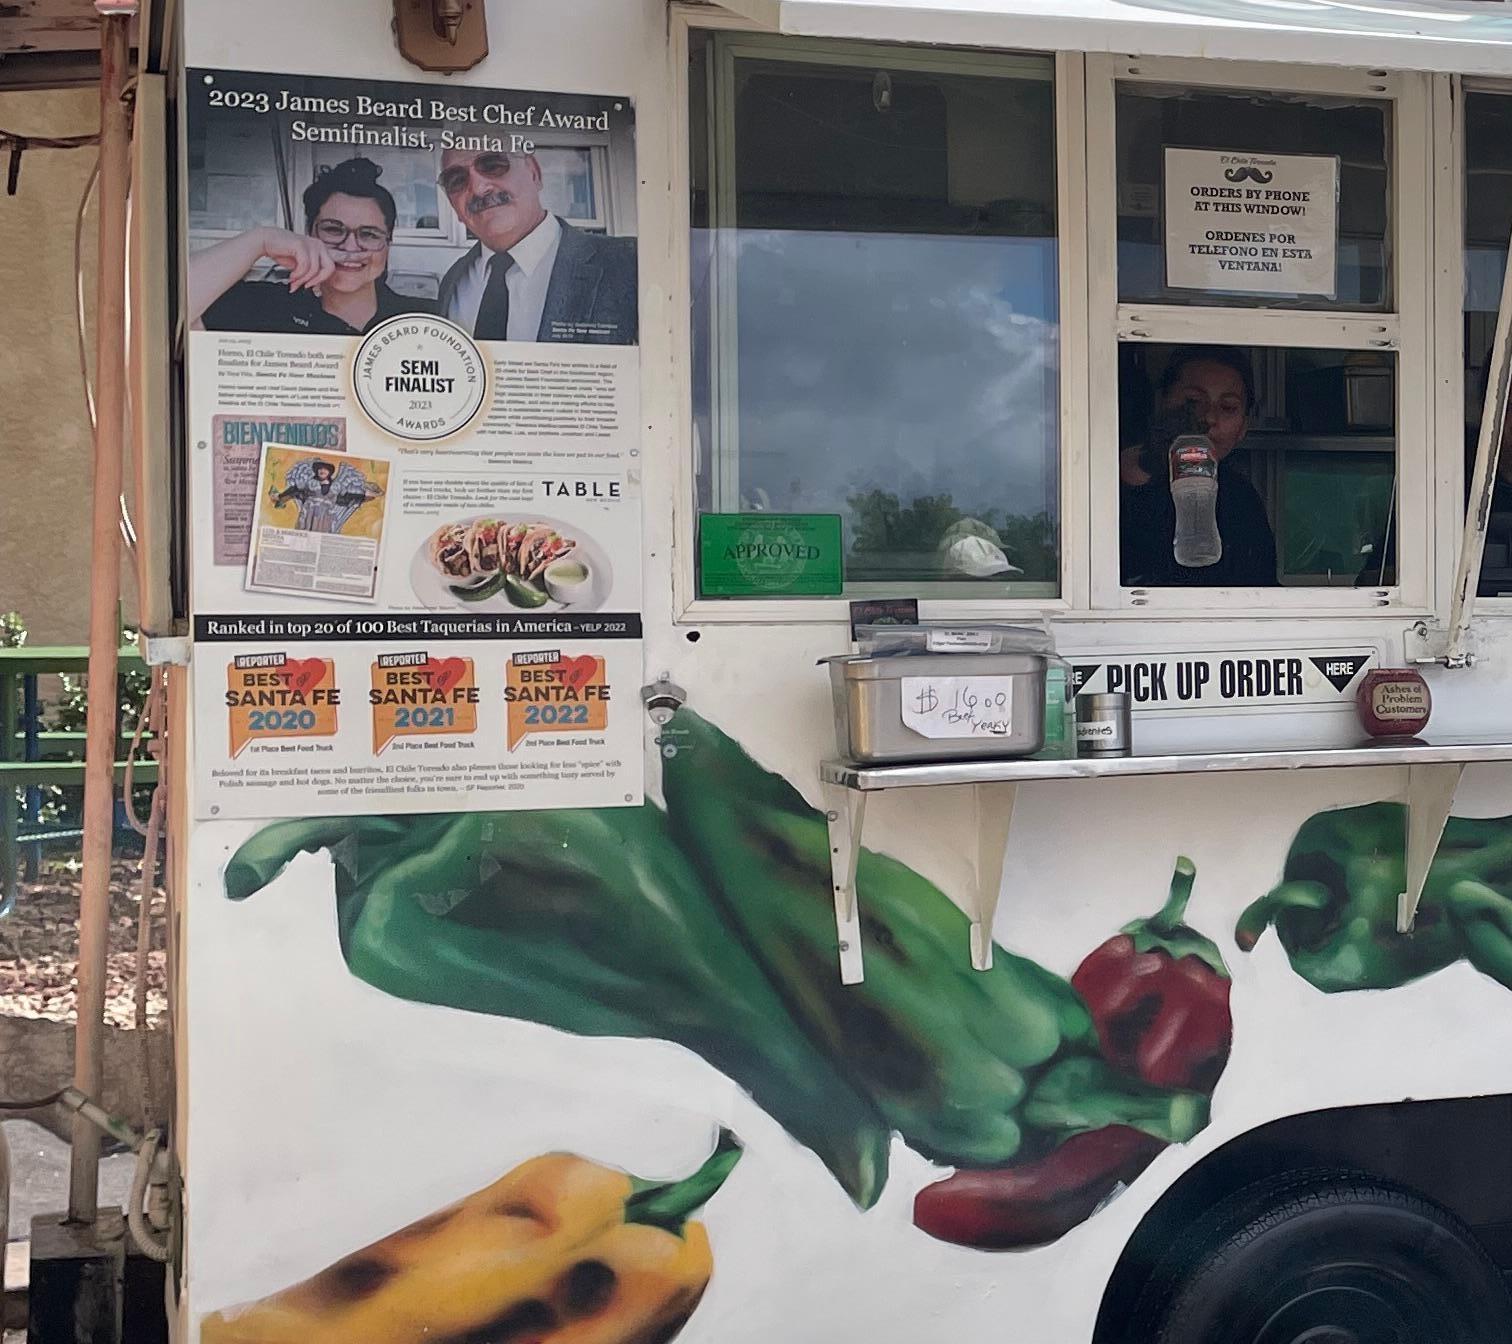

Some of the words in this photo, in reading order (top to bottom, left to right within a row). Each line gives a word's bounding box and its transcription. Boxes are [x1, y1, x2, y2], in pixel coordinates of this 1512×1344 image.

[209, 89, 269, 113] 2023
[275, 90, 349, 115] James
[356, 96, 422, 120] Beard
[430, 101, 476, 122] Best
[483, 104, 536, 127] Chef
[539, 110, 609, 132] Award
[291, 121, 435, 152] Semifinalist,
[441, 131, 502, 154] Santa
[510, 134, 535, 155] Fe
[1190, 186, 1242, 198] ORDERS
[1245, 189, 1261, 200] BY
[1264, 190, 1310, 202] PHONE
[1194, 201, 1211, 212] AT
[1212, 202, 1242, 213] THIS
[1244, 204, 1306, 216] WINDOW!
[1205, 230, 1265, 243] ORDENES
[1269, 233, 1296, 244] POR
[1189, 244, 1258, 257] TELEFONO
[1261, 247, 1278, 258] EN
[1282, 249, 1313, 259] ESTA
[1218, 260, 1282, 272] VENTANA!
[363, 343, 382, 379] JAMES
[381, 326, 419, 345] BEARD
[423, 326, 476, 383] FOUNDATION
[400, 359, 439, 376] SEMI
[385, 376, 455, 393] FINALIST
[397, 417, 446, 430] AWARDS
[541, 481, 621, 497] TABLE
[723, 543, 820, 561] APPROVED
[207, 620, 265, 635] Ranked
[269, 620, 284, 634] in
[286, 620, 311, 637] top
[314, 622, 333, 634] 20
[336, 619, 352, 634] of
[355, 621, 384, 634] 100
[387, 620, 418, 634] Best
[420, 619, 492, 636] Taquerias
[496, 620, 510, 633] in
[513, 619, 572, 633] America
[604, 623, 627, 632] 2022
[239, 653, 285, 668] REPORTER
[382, 653, 428, 666] REPORTER
[517, 651, 560, 665] REPORTER
[520, 669, 566, 683] BEST
[1326, 661, 1354, 676] HERE
[243, 673, 293, 687] BEST
[386, 671, 434, 686] BEST
[1107, 662, 1168, 703] PICK
[1176, 660, 1210, 700] UP
[1219, 657, 1304, 698] ORDER
[368, 687, 447, 705] SANTA
[452, 687, 480, 704] FE
[503, 686, 579, 702] SANTA
[584, 685, 611, 701] FE
[1381, 684, 1411, 694] Ashes
[1412, 685, 1422, 694] of
[225, 689, 309, 707] SANTA
[313, 688, 341, 705] FE
[1382, 694, 1423, 704] Problem
[524, 705, 588, 725] 2022
[1376, 705, 1427, 715] Customers
[249, 710, 316, 731] 2020
[394, 708, 454, 728] 2021
[297, 744, 314, 752] Food
[316, 743, 333, 752] Truck
[440, 741, 456, 749] Food
[457, 741, 475, 749] Truck
[556, 738, 570, 746] Best
[571, 738, 587, 746] Food
[588, 737, 605, 746] Truck
[271, 767, 308, 776] breakfast
[605, 759, 622, 767] with
[279, 778, 294, 787] and
[296, 778, 310, 786] hot
[334, 777, 346, 785] No
[376, 775, 389, 784] the
[501, 772, 518, 781] with
